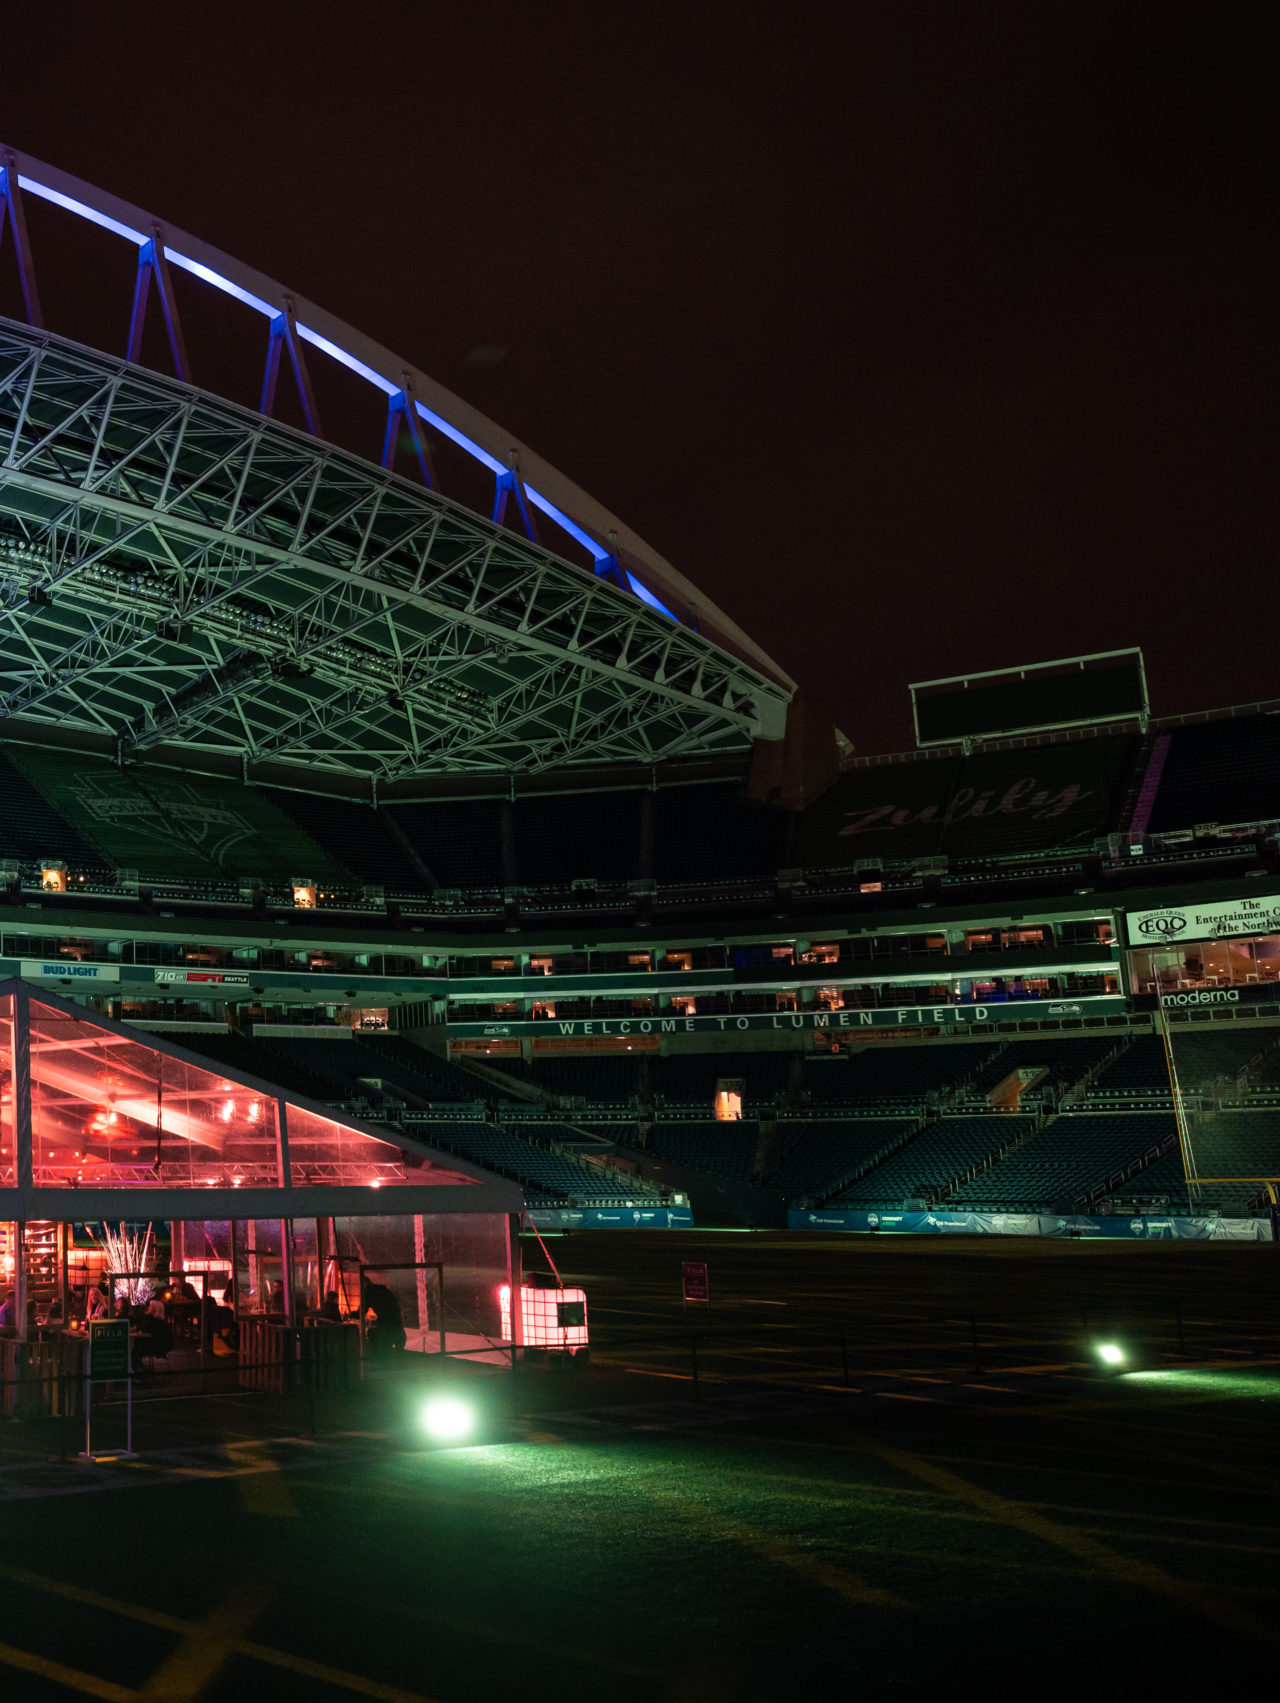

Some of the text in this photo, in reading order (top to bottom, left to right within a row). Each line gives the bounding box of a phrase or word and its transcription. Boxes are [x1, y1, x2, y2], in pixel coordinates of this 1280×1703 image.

[838, 776, 1094, 837] zulily
[1241, 900, 1261, 910] The
[1195, 910, 1270, 925] Entertainment
[1144, 916, 1184, 936] EQC
[1222, 922, 1239, 933] the
[43, 965, 98, 977] BUD LIGHT
[1161, 989, 1240, 1007] moderna
[559, 1007, 989, 1035] WELCOME TO LUMEN FIELD
